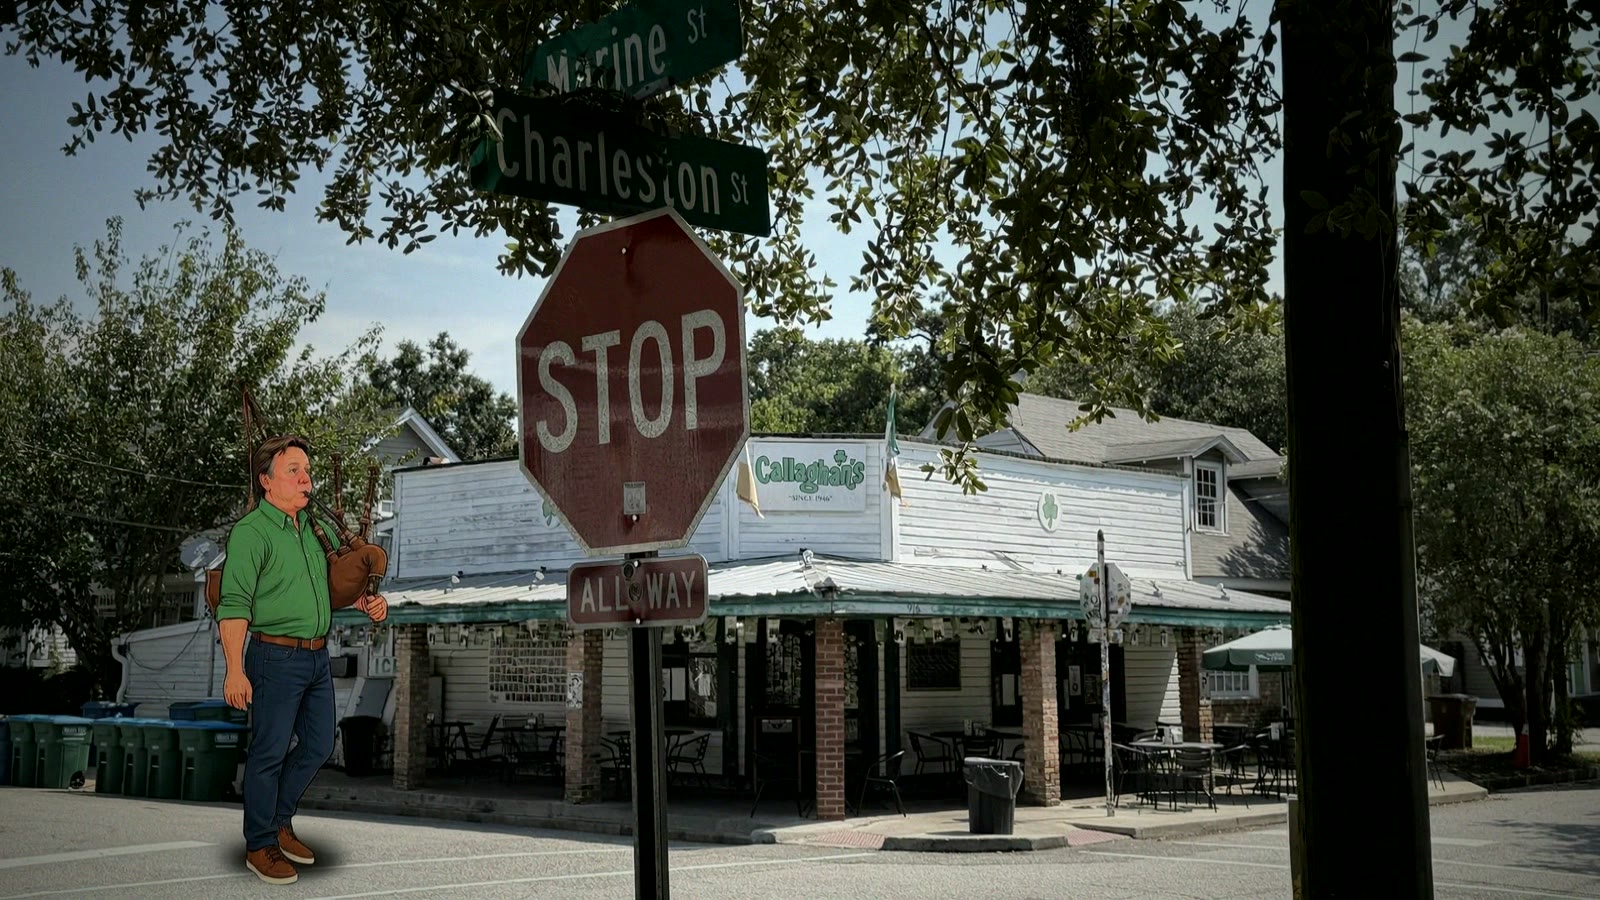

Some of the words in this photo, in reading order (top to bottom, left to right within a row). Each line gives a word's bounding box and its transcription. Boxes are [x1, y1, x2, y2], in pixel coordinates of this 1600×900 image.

[687, 7, 707, 45] St
[496, 106, 720, 216] Charleston
[730, 171, 749, 206] St
[536, 309, 726, 453] STOP
[755, 455, 865, 494] Callaghan's
[580, 572, 629, 614] ALL
[646, 570, 696, 610] WAY
